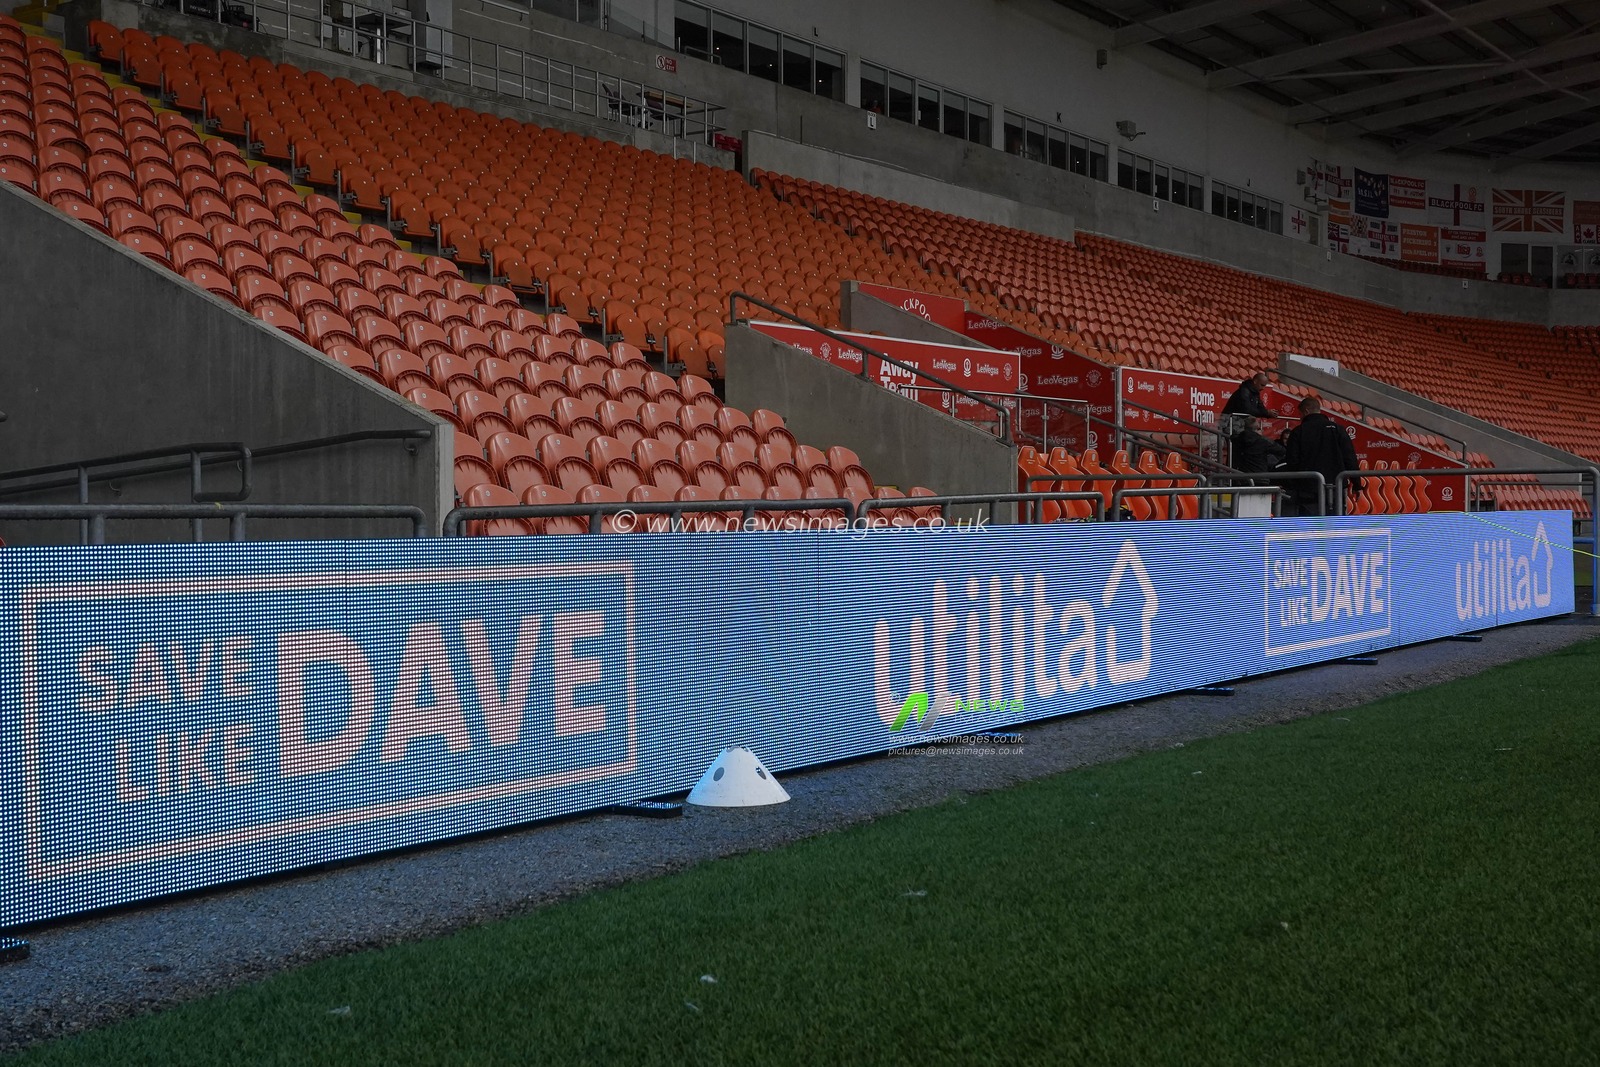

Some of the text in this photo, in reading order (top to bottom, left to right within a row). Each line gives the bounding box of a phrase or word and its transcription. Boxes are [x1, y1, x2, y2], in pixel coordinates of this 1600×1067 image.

[1431, 199, 1473, 210] BLACKPOOL
[1473, 203, 1483, 211] FC
[1494, 206, 1513, 214] SOUTH
[900, 298, 931, 321] CKPOO
[968, 319, 1005, 330] LeoVega
[838, 348, 863, 363] LeoVega
[879, 352, 919, 384] Away
[932, 358, 957, 374] LeoVegas
[976, 363, 999, 376] LeoVegas
[1037, 374, 1079, 386] LeoVegas
[1137, 381, 1155, 392] LeoVegas
[1168, 385, 1184, 395] LeoVegas
[1190, 387, 1215, 407] Home
[1190, 404, 1215, 424] Team
[1367, 440, 1400, 449] LeoVegas
[1274, 558, 1308, 590] SAVE
[1455, 538, 1532, 621] utilita
[1311, 551, 1384, 622] DAVE
[1280, 598, 1308, 627] LIKE
[874, 573, 1099, 726] utilita
[78, 634, 250, 712] SAVE
[278, 611, 606, 778] DAVE
[115, 724, 255, 803] LIKE
